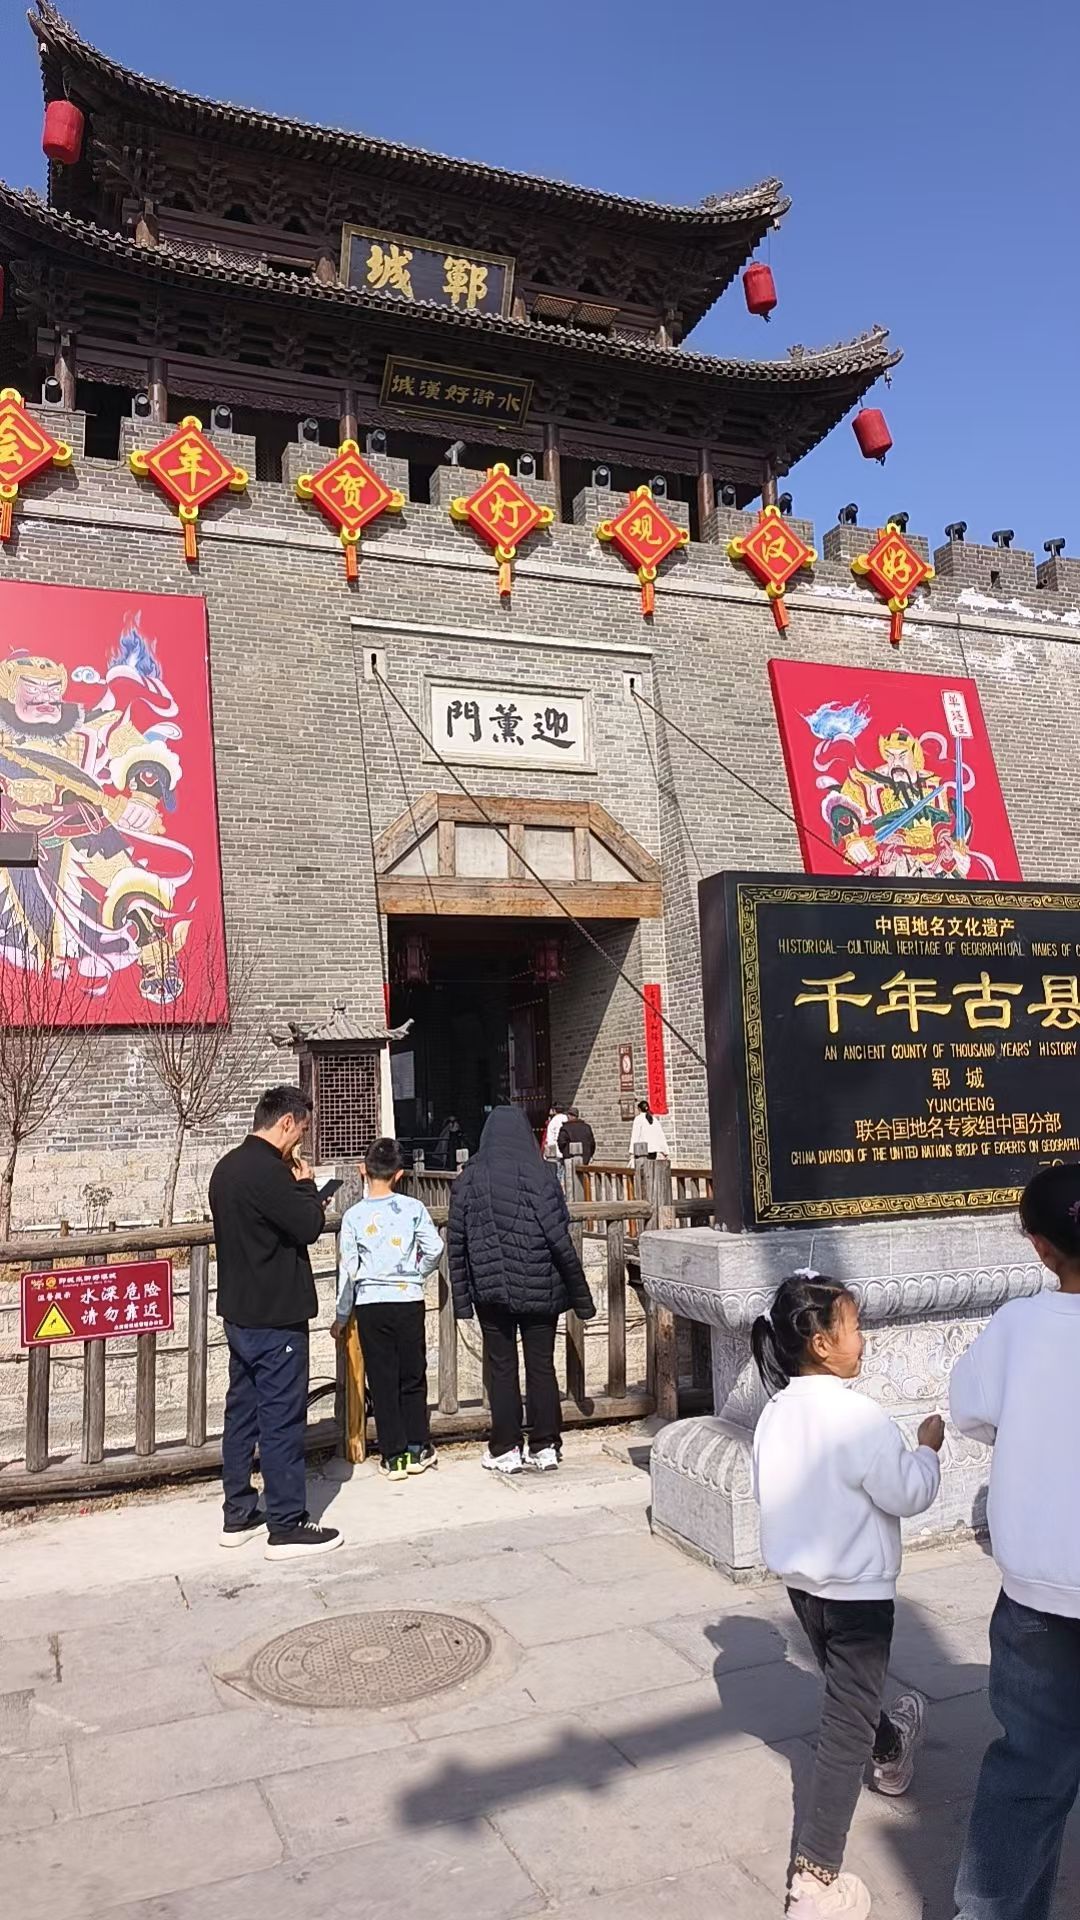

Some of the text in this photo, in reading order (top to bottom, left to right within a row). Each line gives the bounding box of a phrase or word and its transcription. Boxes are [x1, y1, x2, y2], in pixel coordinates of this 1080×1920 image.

[168, 443, 210, 492] 年
[331, 469, 367, 511] 贺
[490, 494, 522, 529] 灯
[630, 514, 663, 546] 观
[760, 530, 794, 562] 汉
[882, 546, 911, 582] 好
[875, 915, 1015, 937] 中国地名文化遗产
[945, 941, 956, 956] OF
[1031, 943, 1058, 957] NAMES
[1061, 943, 1072, 957] OF
[794, 970, 1080, 1034] 千年古县
[824, 1044, 838, 1060] AN
[843, 1044, 886, 1060] ANCIENT
[891, 1043, 928, 1060] COUNTY
[932, 1043, 945, 1059] OF
[950, 1042, 995, 1058] THOUSAND
[1038, 1041, 1077, 1056] HISTORY
[926, 1096, 995, 1113] YUNCHENG
[855, 1111, 1062, 1142] 联合国地名专家组中国分部
[791, 1150, 817, 1165] CHINA
[818, 1148, 855, 1165] DIVISION
[857, 1147, 868, 1162] OF
[872, 1146, 887, 1161] THE
[889, 1145, 919, 1160] UNITED
[921, 1143, 953, 1159] NATIONS
[955, 1142, 978, 1157] GROUP
[981, 1141, 992, 1156] OF
[994, 1140, 1026, 1155] EXPERTS
[1029, 1139, 1039, 1153] ON
[80, 1280, 162, 1305] 水深危险
[80, 1301, 162, 1326] 请勿靠近
